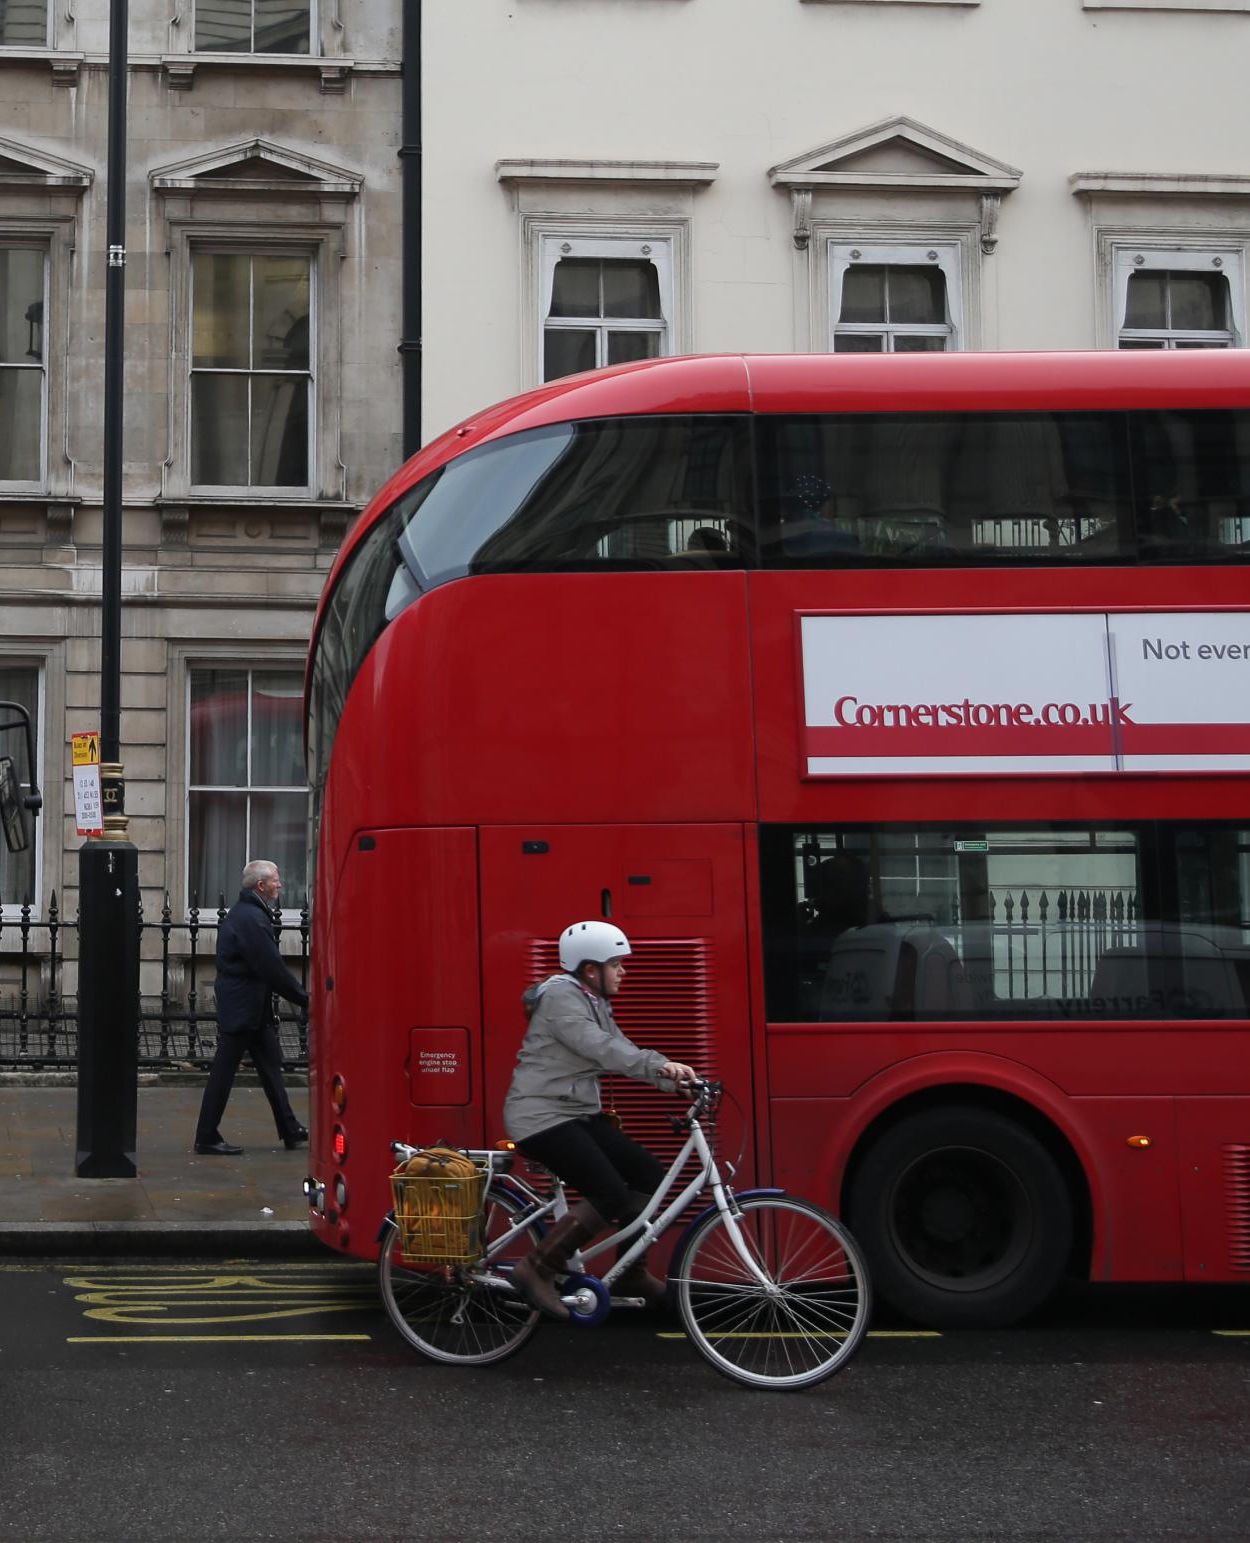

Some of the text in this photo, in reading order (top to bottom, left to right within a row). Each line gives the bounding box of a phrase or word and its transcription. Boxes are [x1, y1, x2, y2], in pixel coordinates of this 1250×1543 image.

[1142, 638, 1190, 660] Not
[834, 695, 1136, 726] Cornerstone.co.uk
[420, 1051, 455, 1059] Emergency
